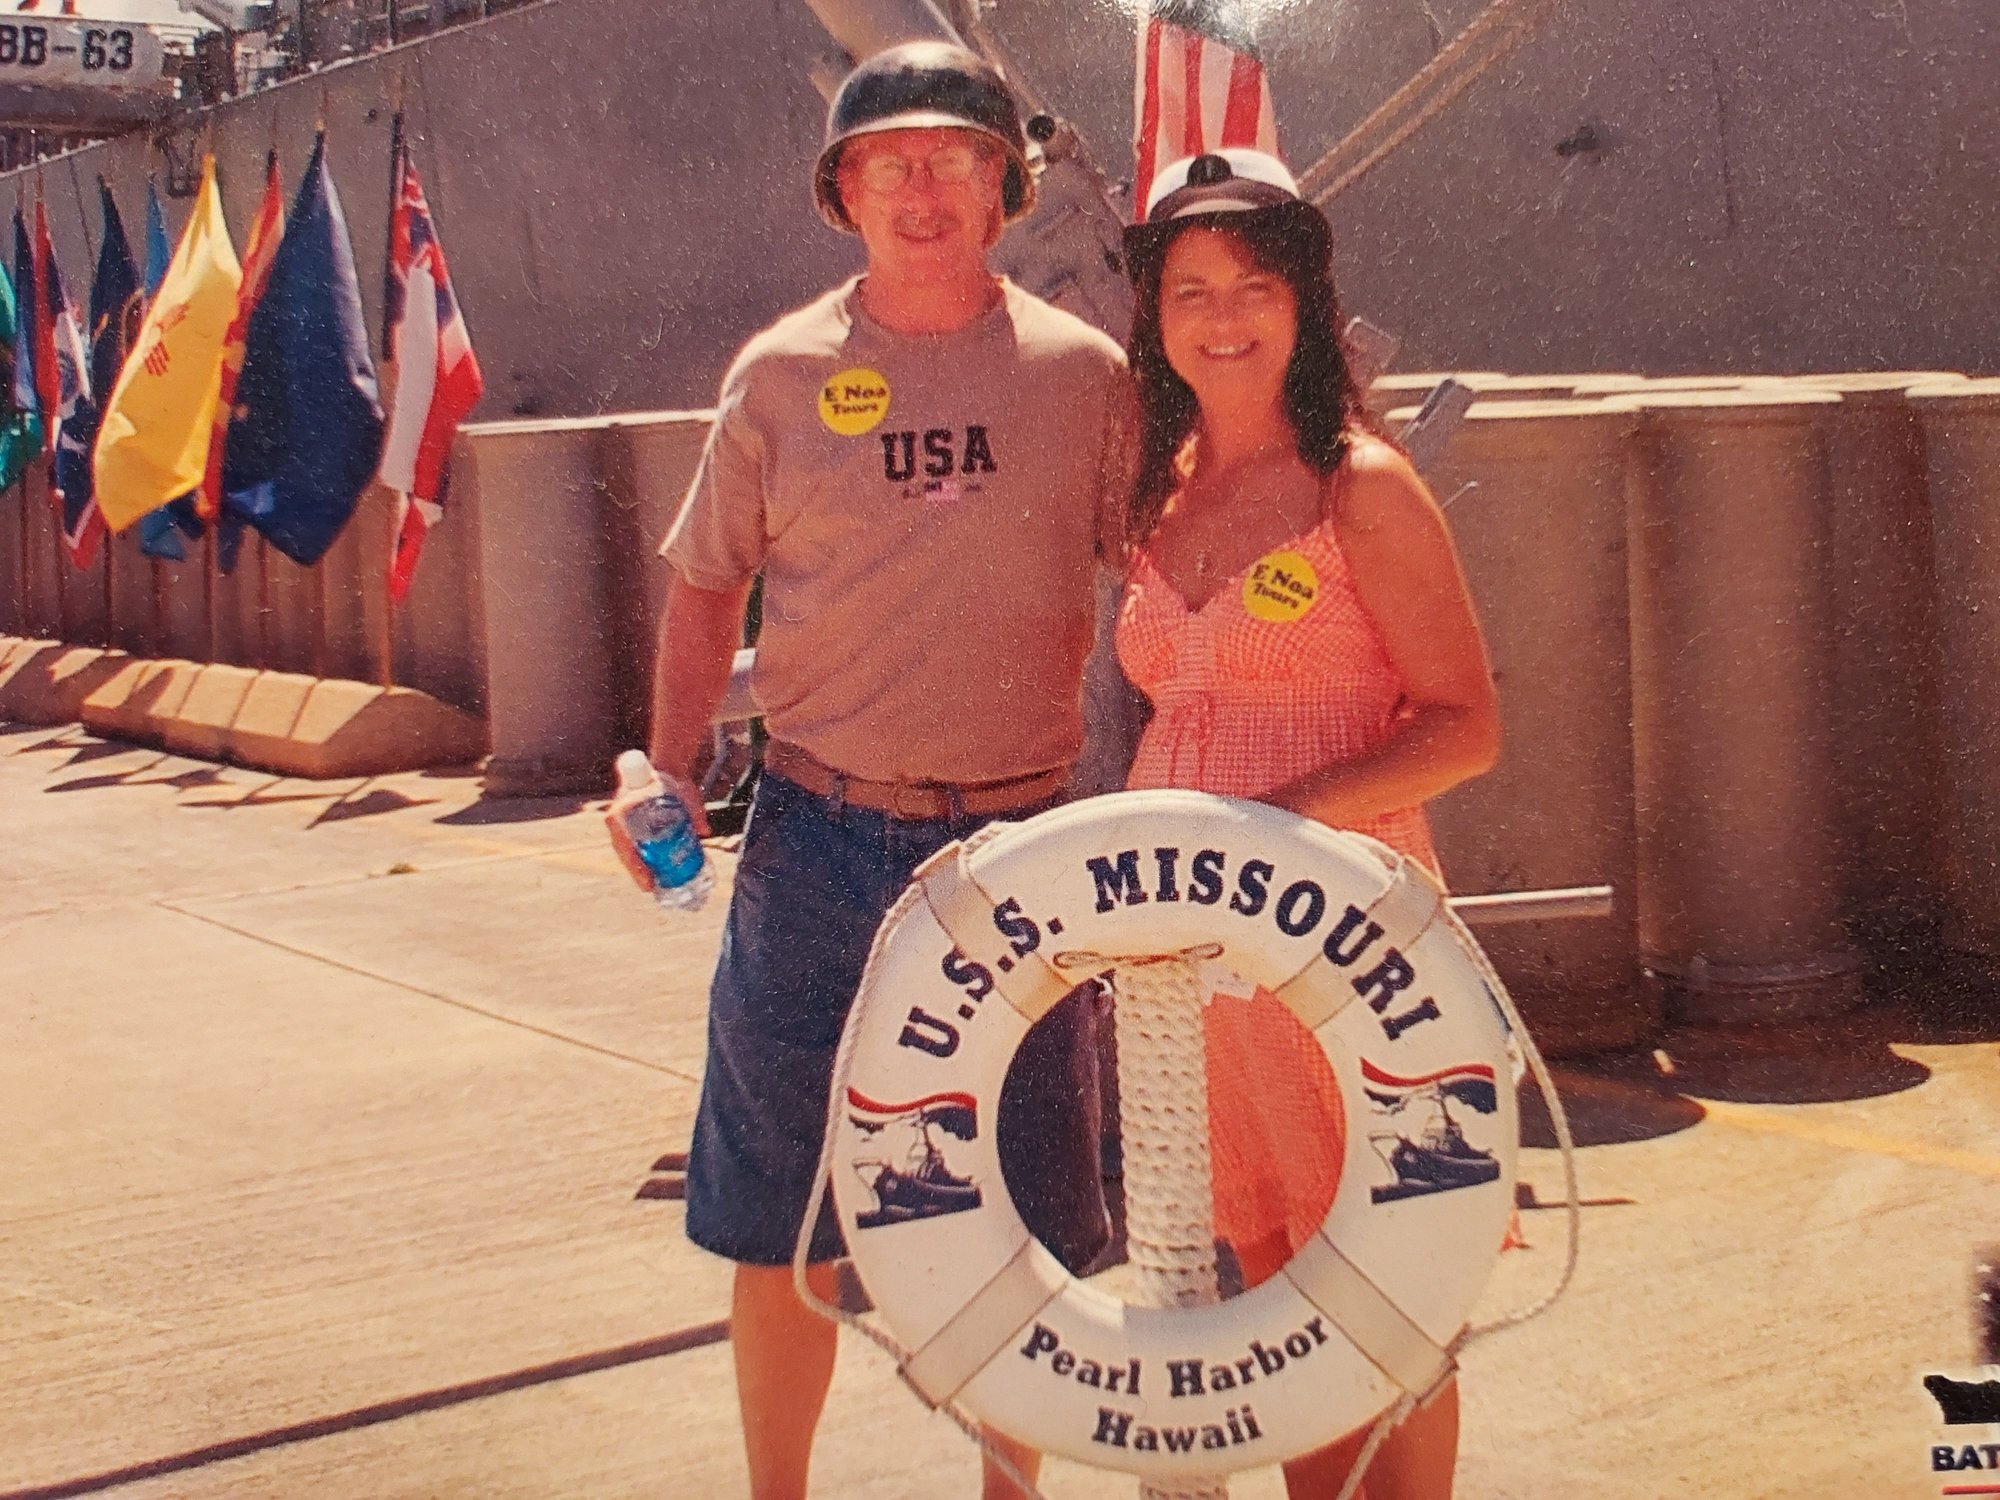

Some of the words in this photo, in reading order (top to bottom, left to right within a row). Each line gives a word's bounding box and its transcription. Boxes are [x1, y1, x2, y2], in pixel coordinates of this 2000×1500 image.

[0, 24, 134, 70] BB-63
[824, 387, 838, 401] E
[844, 384, 887, 399] Noa
[881, 425, 997, 482] USA
[1253, 564, 1270, 580] E
[1270, 568, 1313, 599] Noa
[897, 897, 1063, 1059] U.S.S.
[1086, 847, 1441, 1041] MISSOURI
[1020, 1322, 1141, 1395] Pearl
[1167, 1317, 1330, 1398] Harbor
[1092, 1404, 1262, 1453] Hawaii
